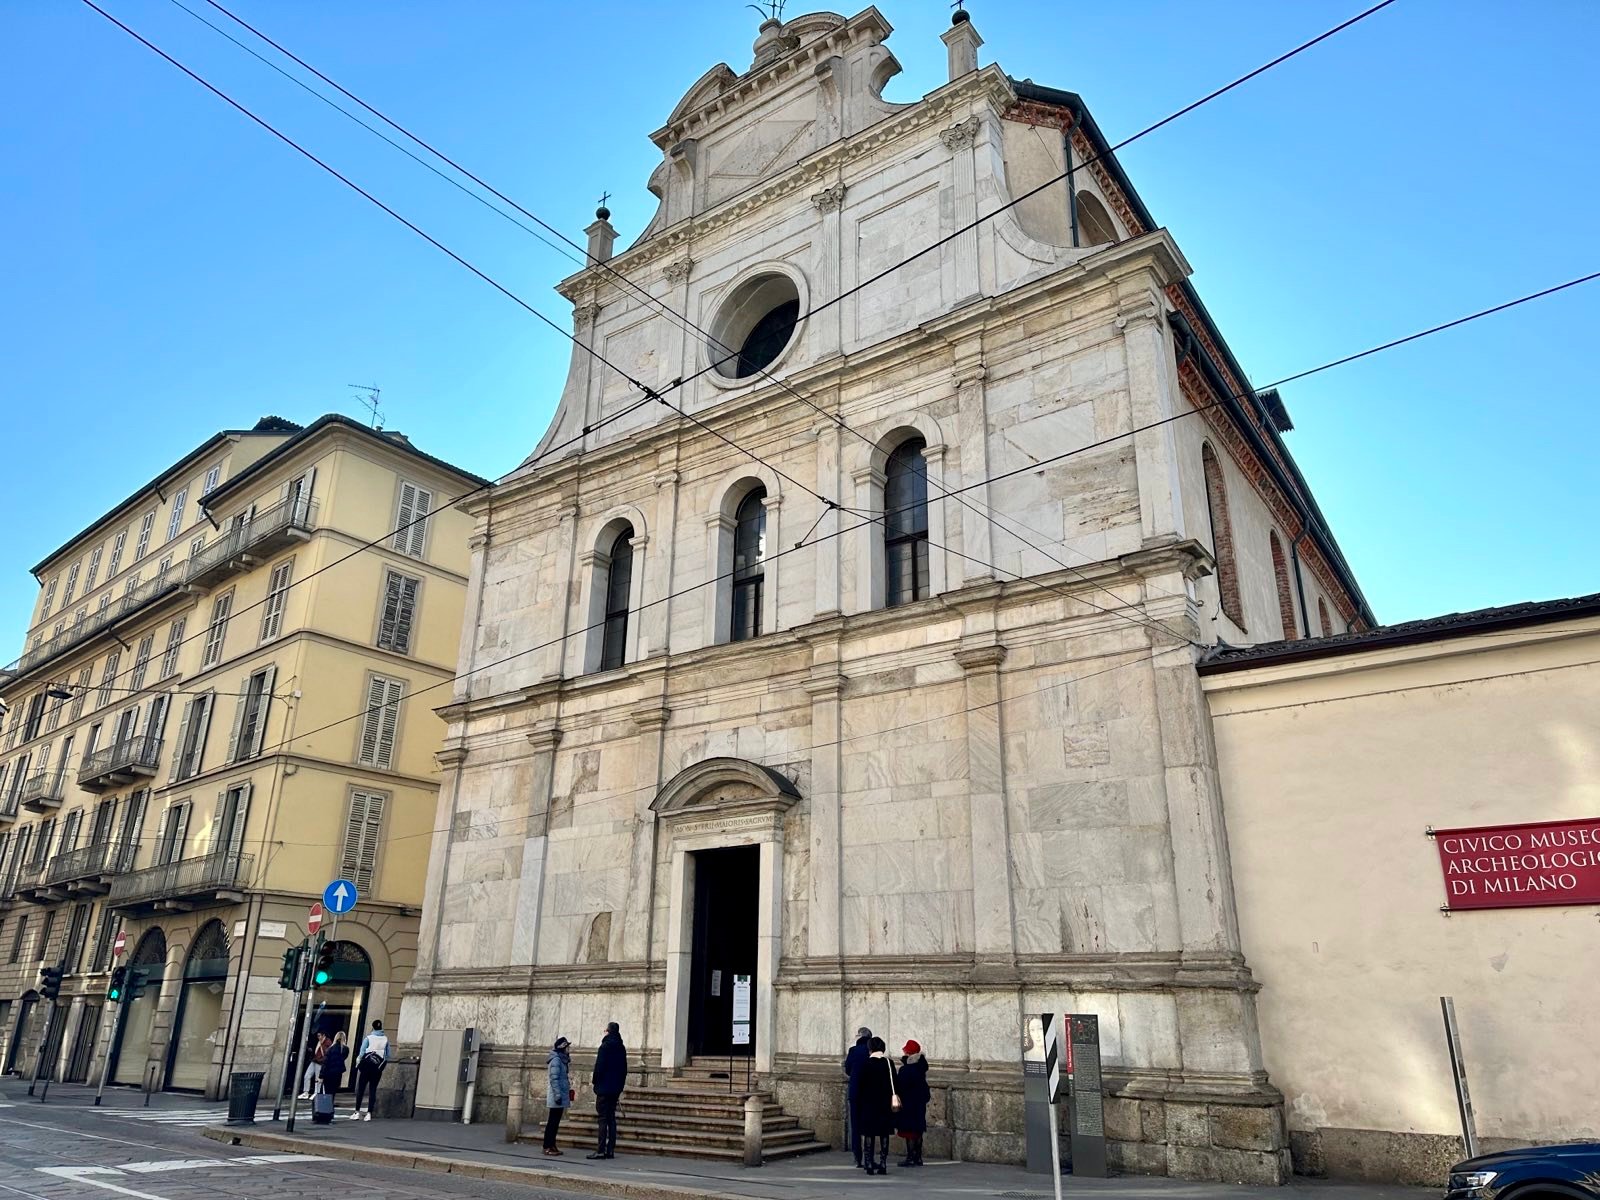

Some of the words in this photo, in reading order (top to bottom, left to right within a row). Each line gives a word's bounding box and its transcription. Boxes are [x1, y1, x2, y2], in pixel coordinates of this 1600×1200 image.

[1443, 834, 1522, 854] CIVICO
[1447, 850, 1600, 875] ARCHEOLOGI
[1451, 878, 1476, 895] DI
[1484, 873, 1577, 894] MILANO
